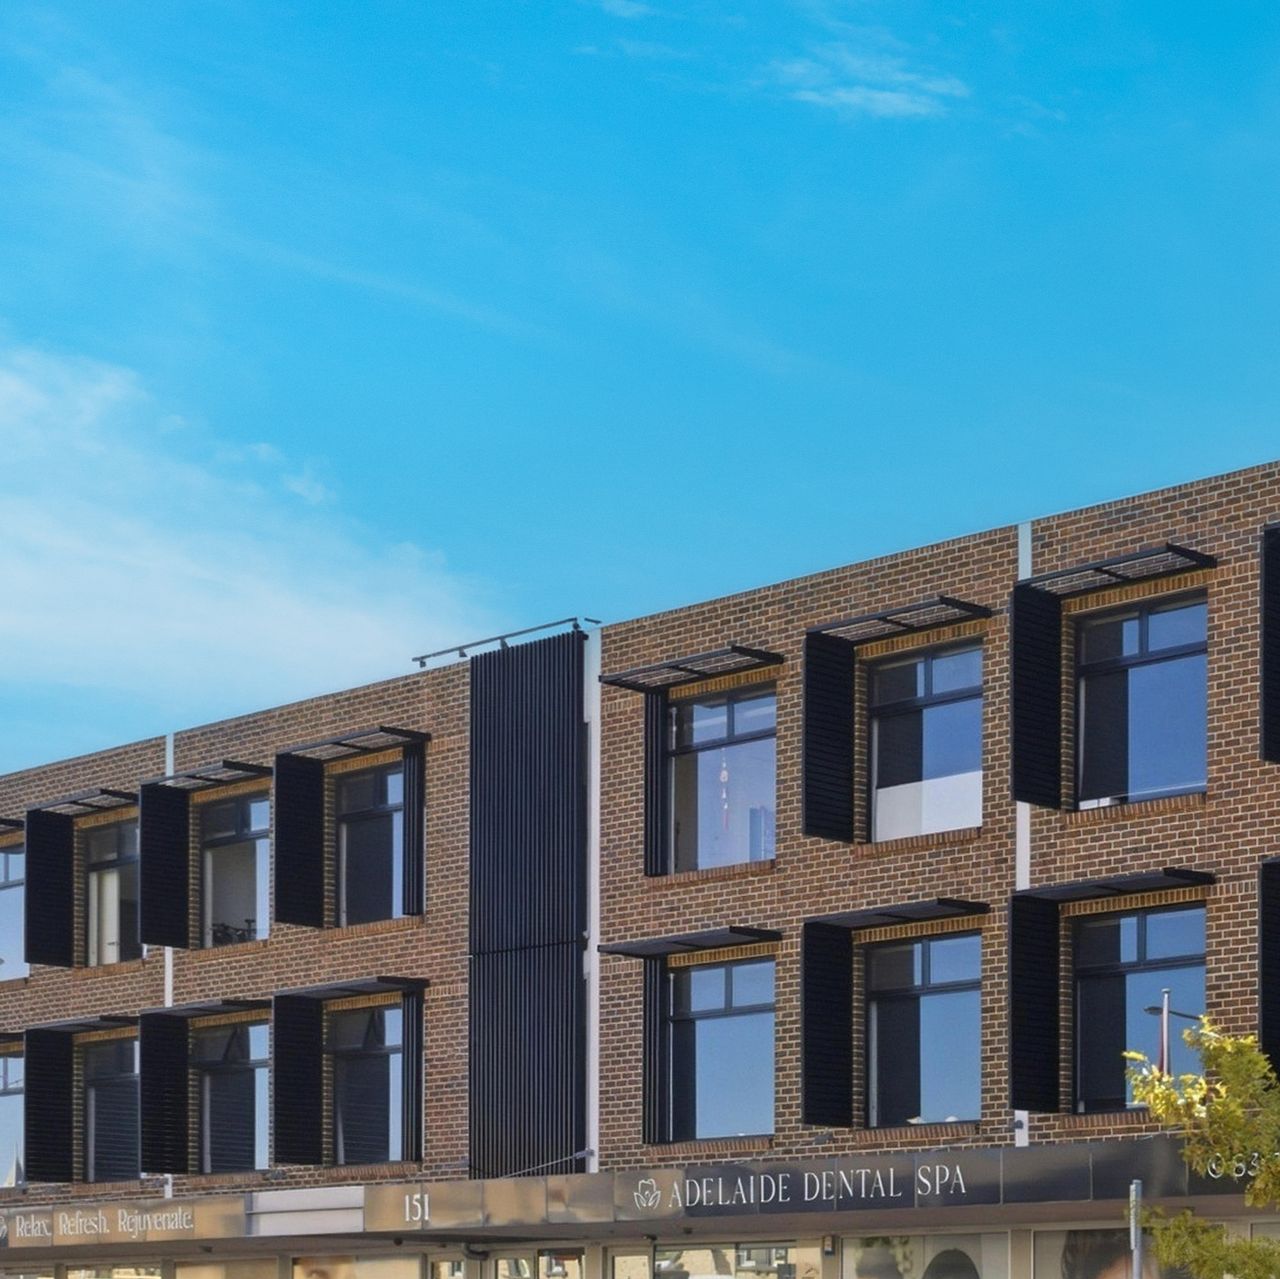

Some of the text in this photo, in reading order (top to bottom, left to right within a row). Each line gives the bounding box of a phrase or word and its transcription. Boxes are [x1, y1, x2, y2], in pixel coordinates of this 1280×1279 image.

[668, 1164, 966, 1208] ADELAIDE DENTAL SPA
[59, 1210, 110, 1236] Refresh.
[117, 1206, 194, 1239] Rejuvenate.
[405, 1194, 429, 1221] 151
